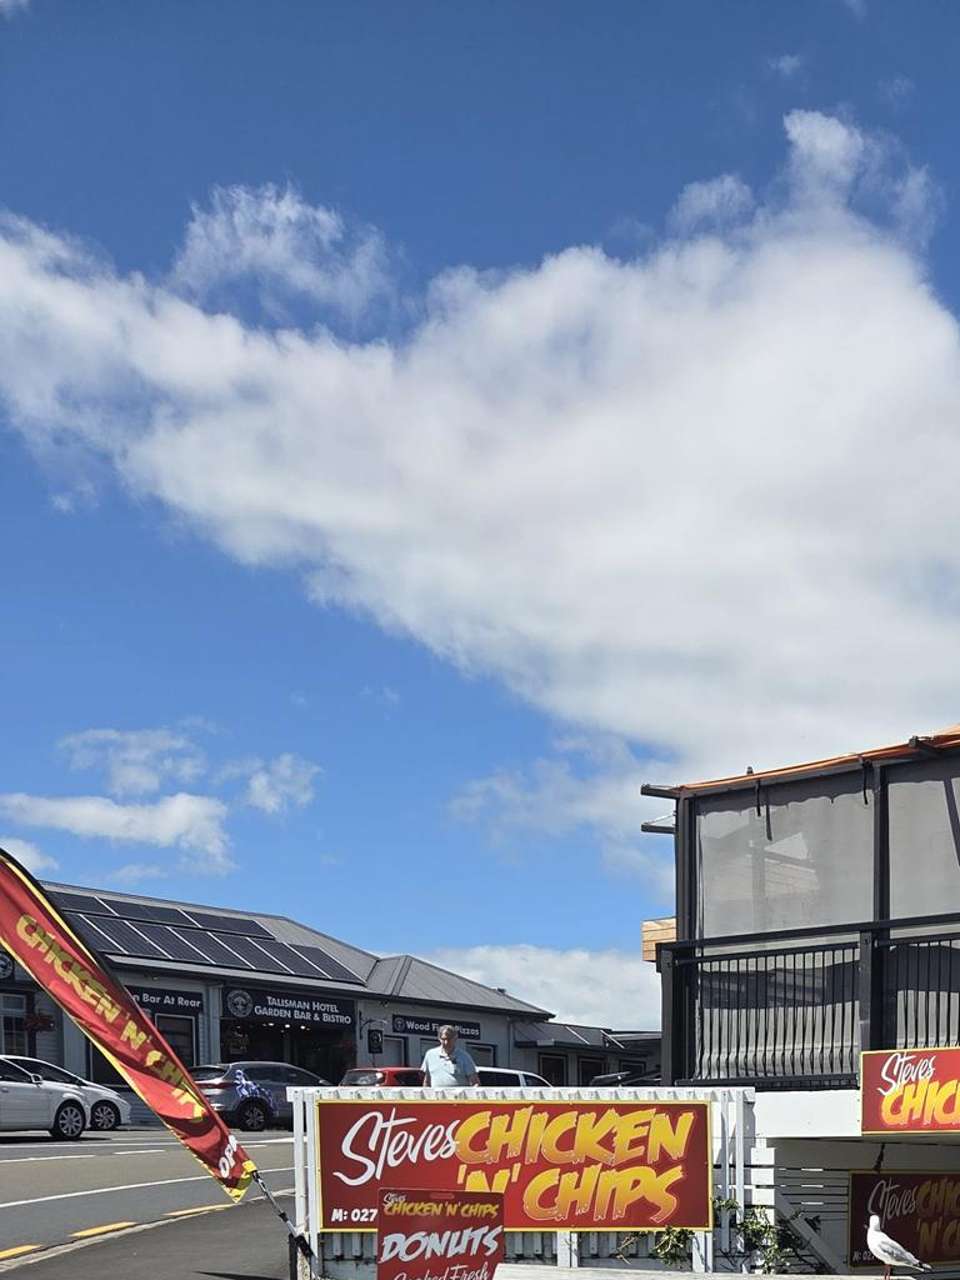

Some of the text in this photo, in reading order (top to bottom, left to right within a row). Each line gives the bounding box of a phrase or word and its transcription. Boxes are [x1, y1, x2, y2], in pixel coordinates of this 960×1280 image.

[142, 993, 161, 1004] Bar
[177, 997, 201, 1008] Rear
[406, 1020, 430, 1031] Wood
[878, 1050, 935, 1096] Steves
[332, 1104, 695, 1187] Steves CHICKEN
[523, 1164, 684, 1223] CHIPS
[351, 1208, 378, 1222] 027
[384, 1201, 444, 1217] CHICKEN
[460, 1202, 499, 1219] CHIPS
[378, 1225, 503, 1264] DONUTS
